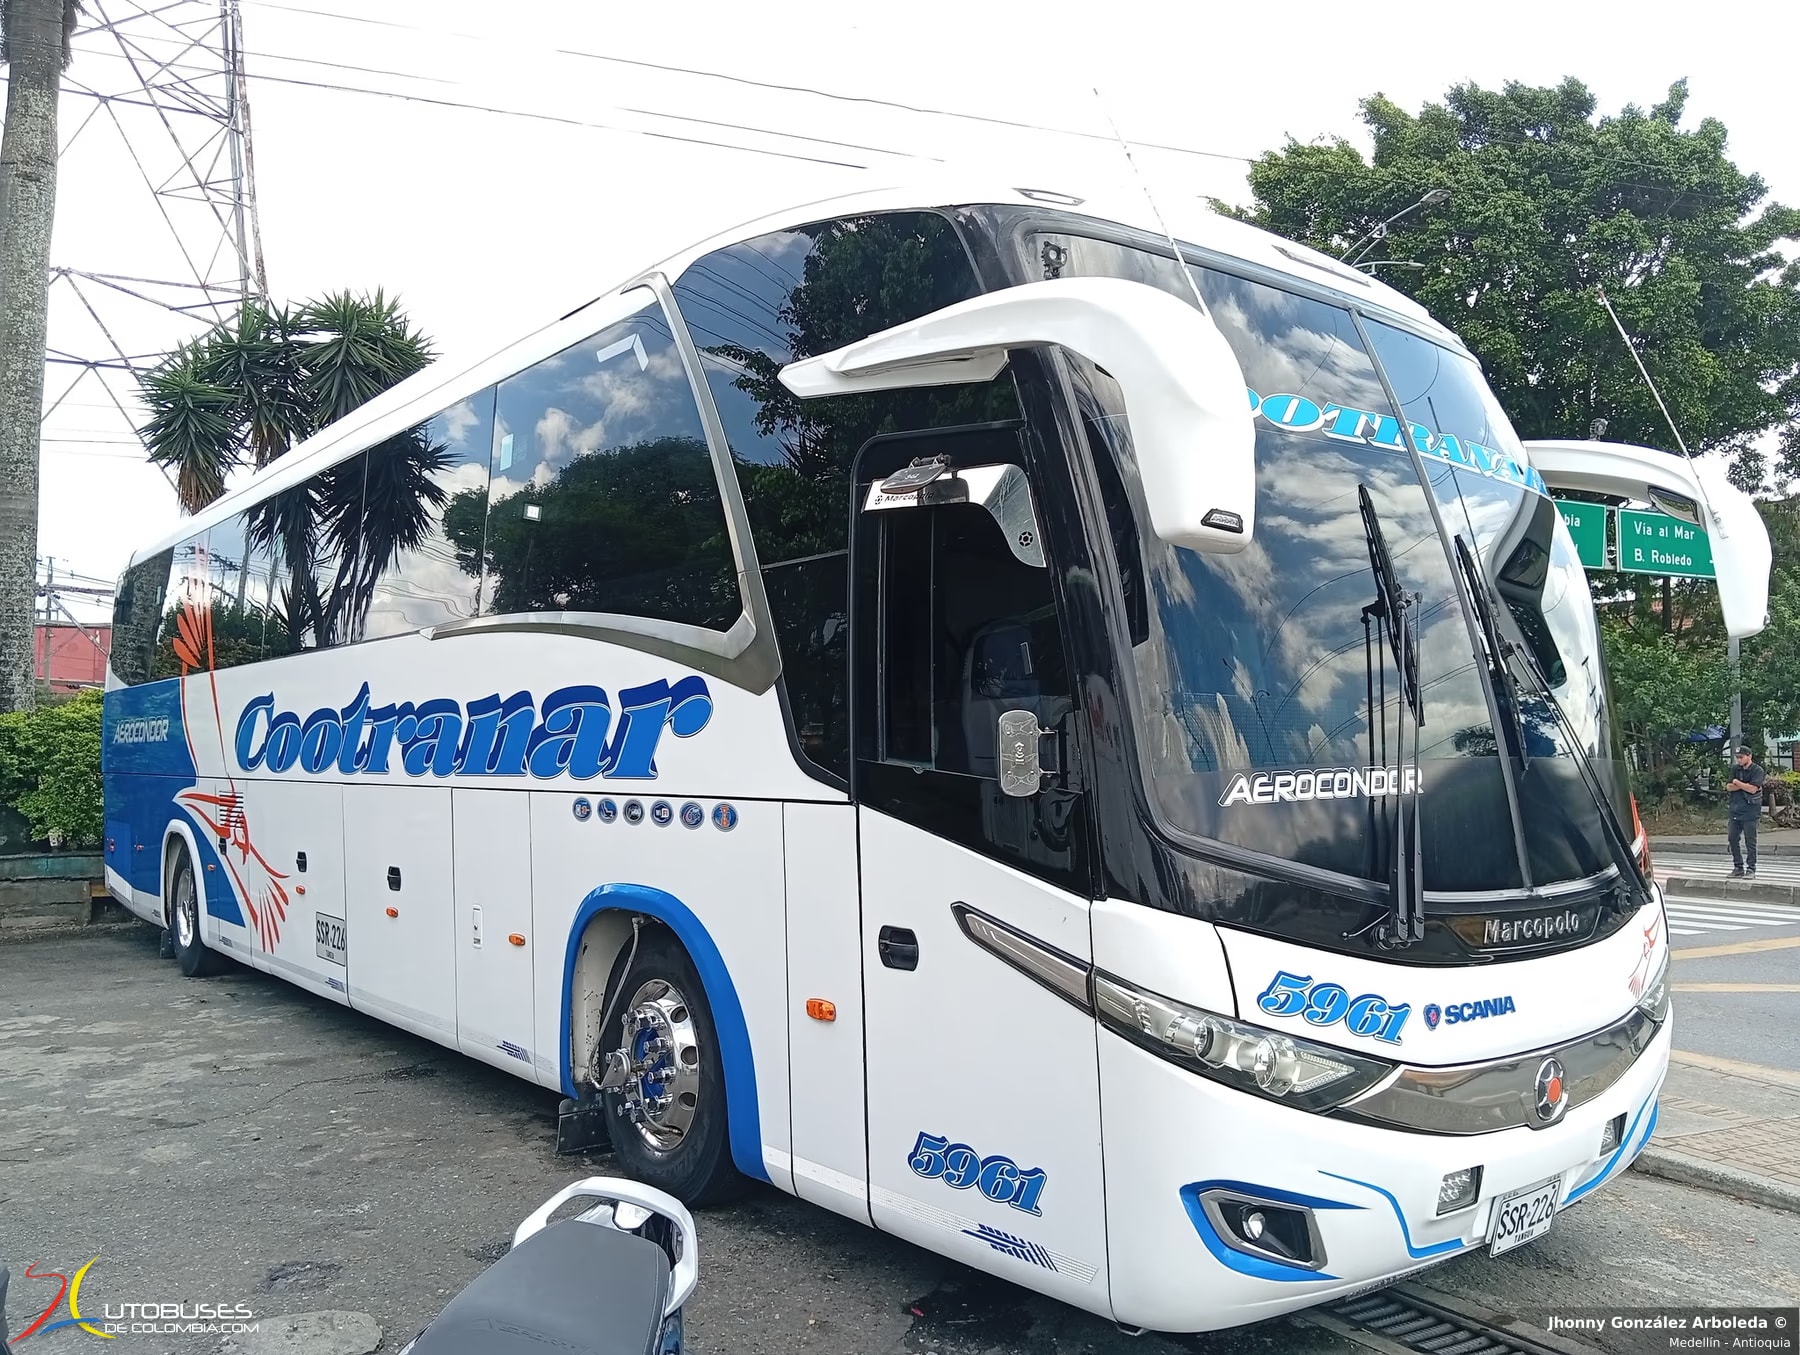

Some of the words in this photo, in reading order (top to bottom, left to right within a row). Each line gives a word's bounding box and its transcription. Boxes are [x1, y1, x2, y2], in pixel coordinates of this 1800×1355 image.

[1246, 386, 1552, 499] OTRANAR
[1564, 514, 1581, 527] bia
[1659, 526, 1668, 537] al
[1675, 525, 1695, 540] Mar
[1634, 548, 1645, 562] B.
[1651, 550, 1692, 566] Robledo
[112, 715, 168, 745] AEROCONDOR
[234, 675, 715, 781] Cootranar
[1218, 765, 1424, 807] AEROCONDOR
[1483, 910, 1579, 944] Marcopolo
[1256, 970, 1411, 1046] 5961
[1444, 995, 1516, 1025] SCANIA
[907, 1131, 1047, 1217] 5961
